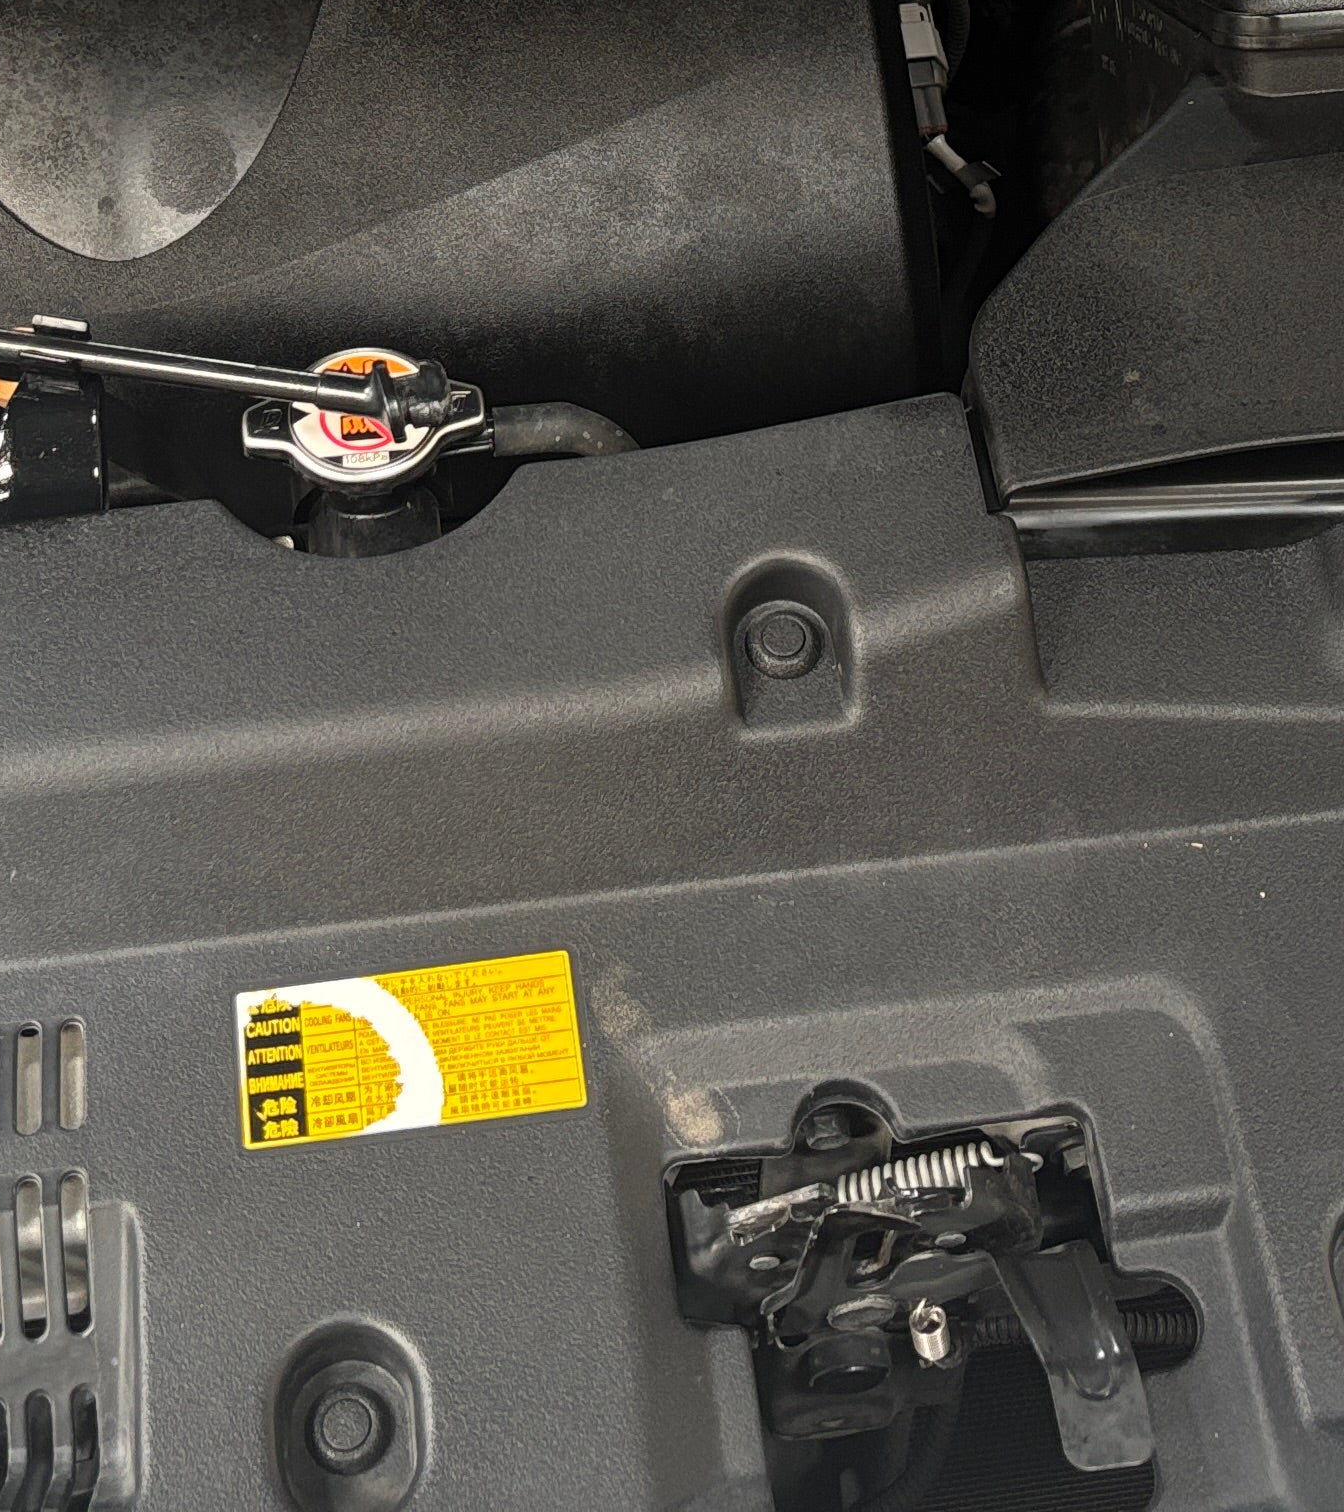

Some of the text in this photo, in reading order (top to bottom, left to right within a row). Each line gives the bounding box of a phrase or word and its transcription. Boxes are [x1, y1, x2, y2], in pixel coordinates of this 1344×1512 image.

[246, 1017, 301, 1038] CAUTION
[304, 1014, 333, 1028] COOLING
[248, 1044, 303, 1066] ATTENTION
[306, 1039, 355, 1056] VENTILATEURS
[248, 1072, 305, 1095] ВНИМАНИЕ
